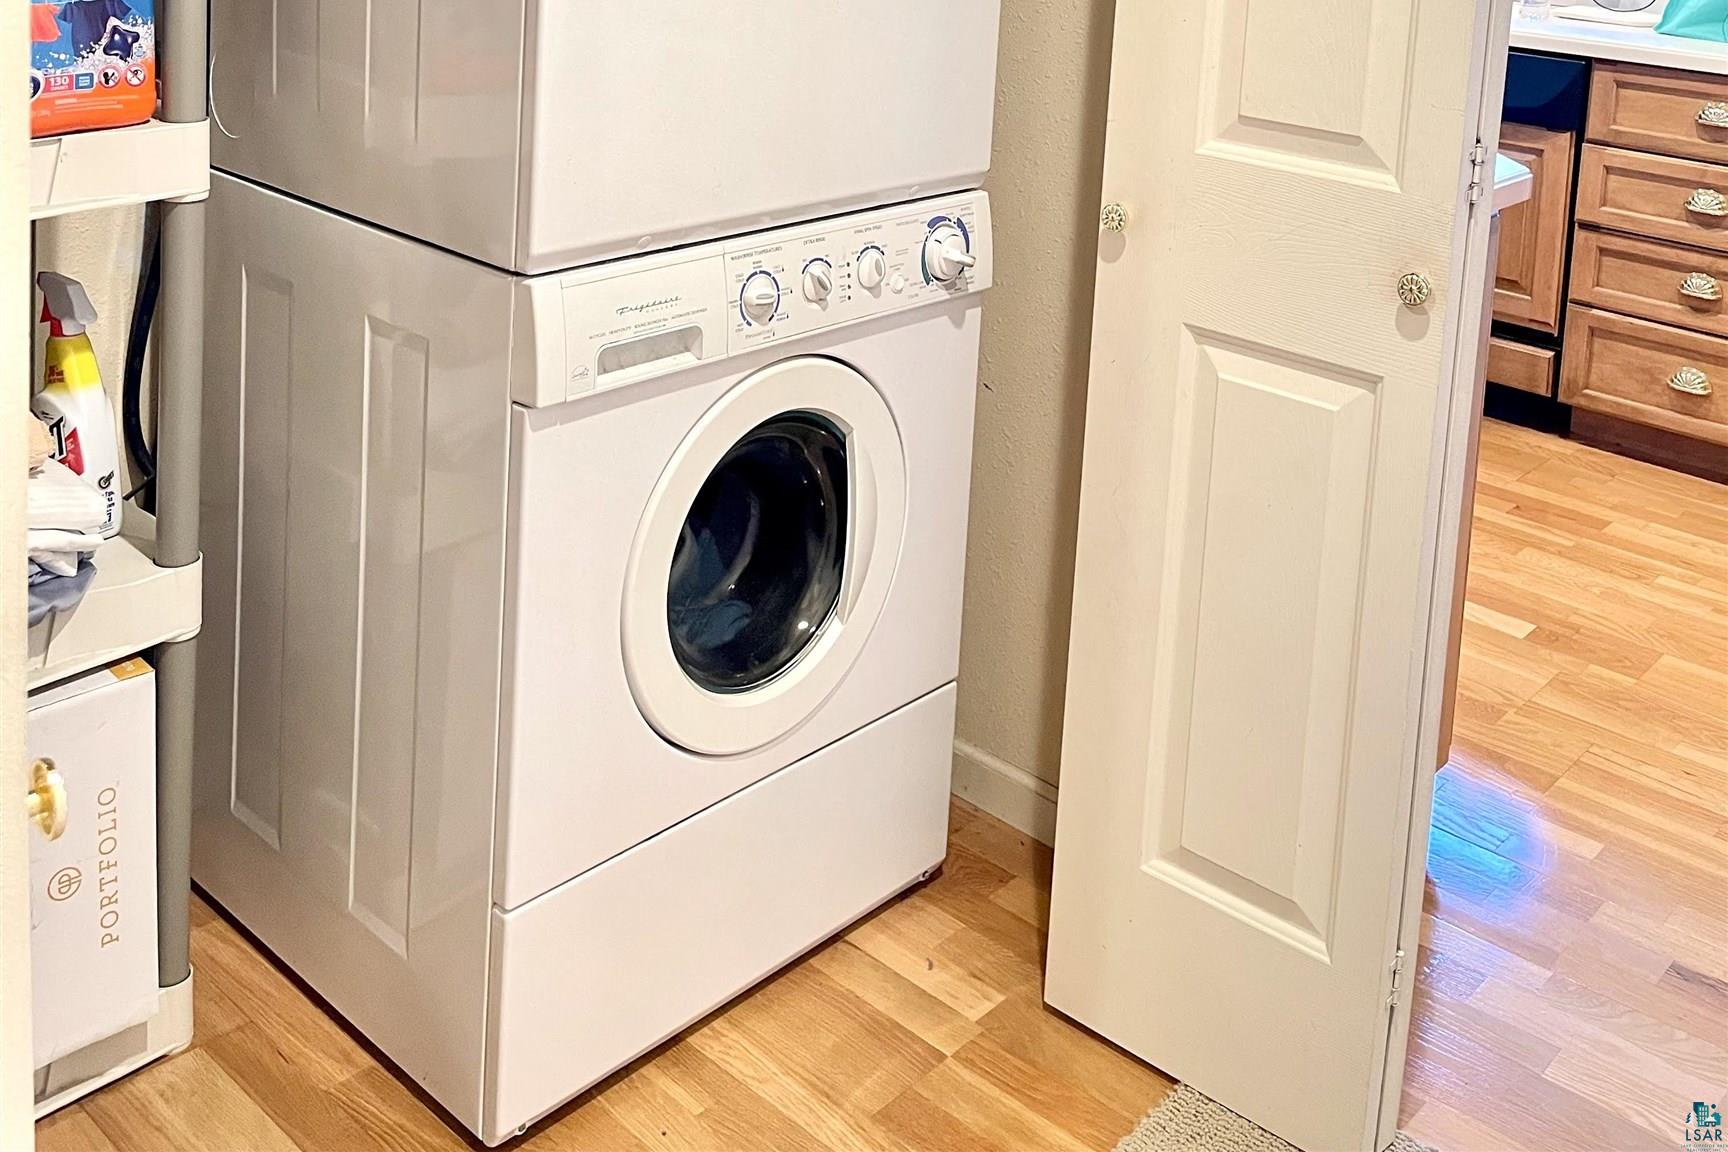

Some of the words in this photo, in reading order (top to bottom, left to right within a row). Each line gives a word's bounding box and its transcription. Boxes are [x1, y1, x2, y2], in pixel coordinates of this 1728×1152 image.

[49, 76, 70, 86] 130
[615, 295, 683, 317] Frigidaire
[96, 786, 120, 949] PORTFOLIO
